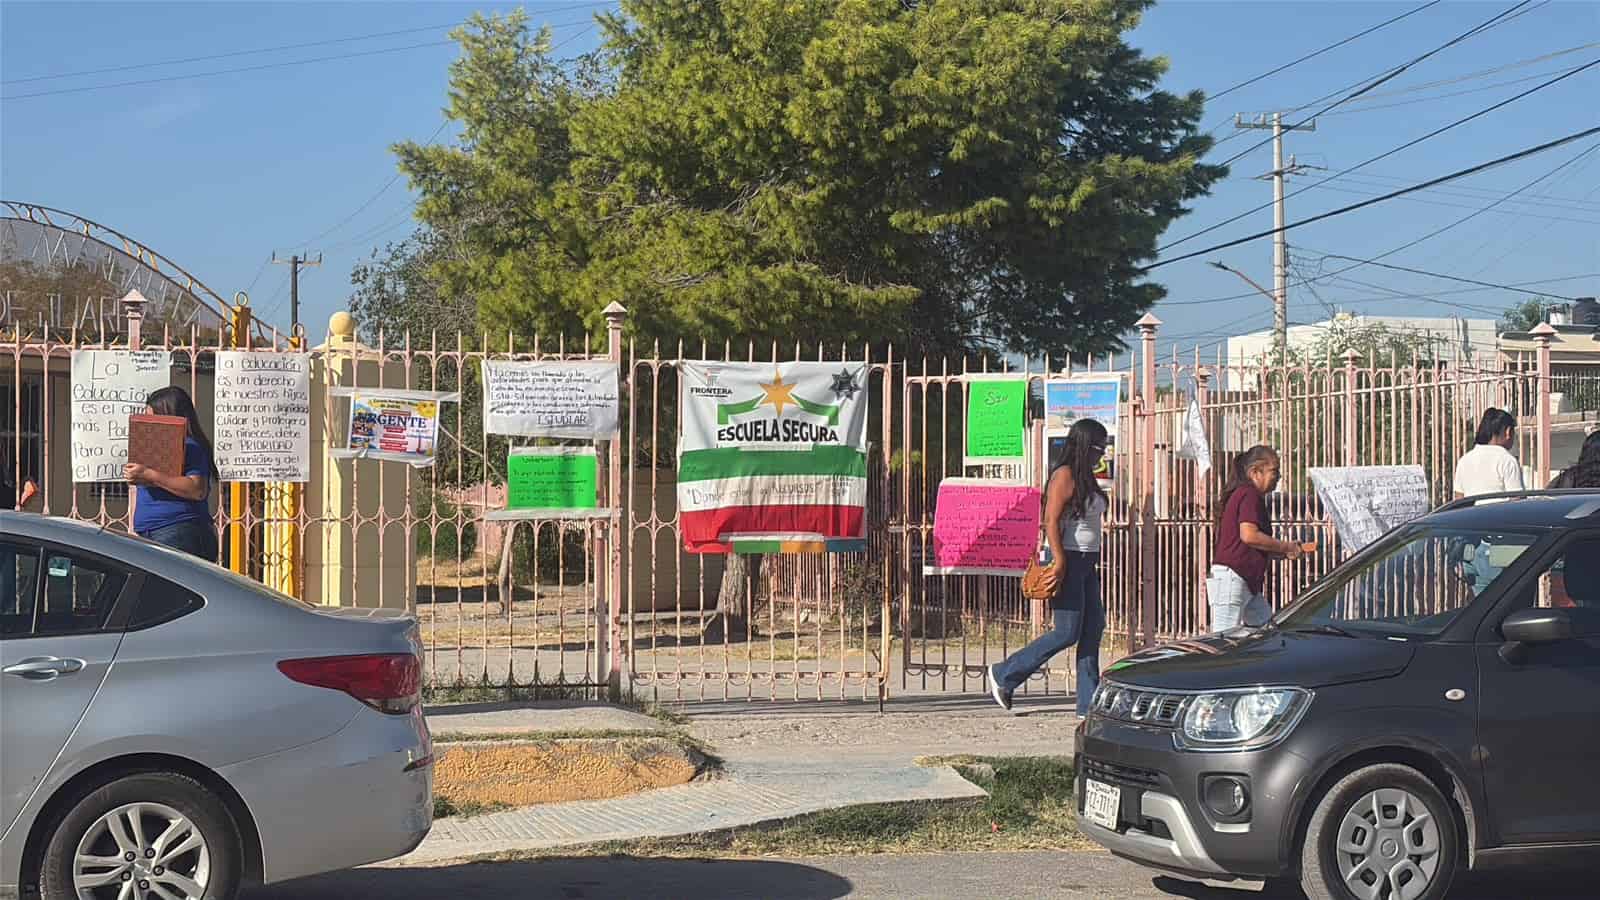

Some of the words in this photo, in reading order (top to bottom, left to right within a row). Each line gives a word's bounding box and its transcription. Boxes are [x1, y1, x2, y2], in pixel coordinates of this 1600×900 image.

[89, 352, 119, 381] La
[217, 376, 232, 386] es
[236, 376, 250, 385] un
[253, 375, 296, 386] derecho
[216, 388, 231, 398] de
[235, 388, 278, 399] nuestros
[690, 387, 733, 395] FRONTERA
[82, 403, 97, 414] es
[103, 403, 115, 414] el
[216, 403, 251, 413] educar
[253, 404, 271, 413] con
[73, 419, 100, 432] más
[253, 416, 259, 427] y
[537, 415, 587, 425] ESTUDIAR
[275, 428, 301, 438] debe
[717, 419, 779, 441] ESCUELA
[783, 419, 839, 442] SEGURA
[241, 440, 293, 450] PRIORIDAD
[275, 457, 281, 466] y
[284, 456, 299, 464] del
[76, 464, 90, 479] el
